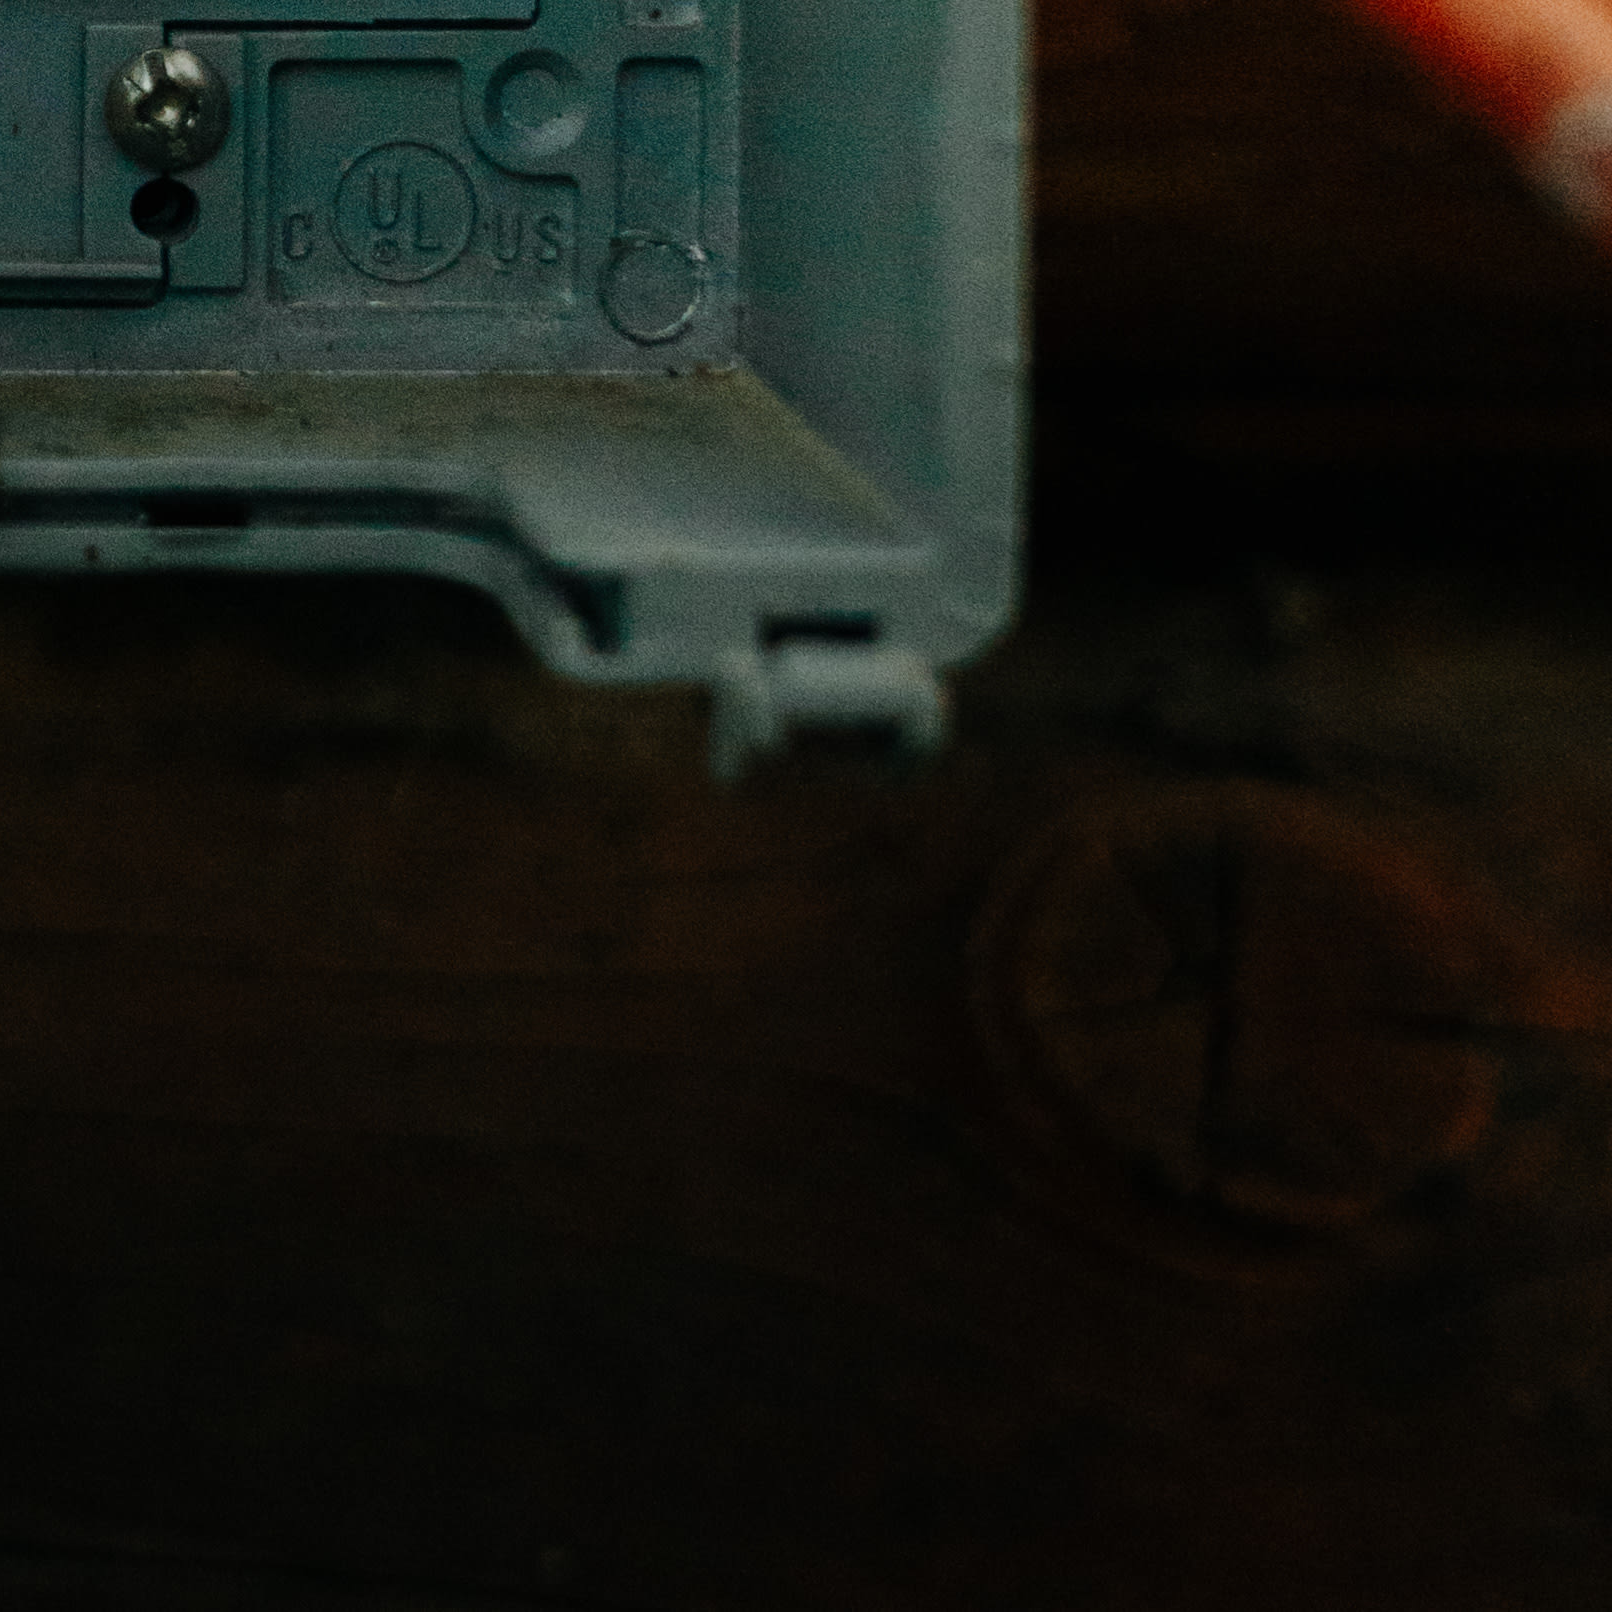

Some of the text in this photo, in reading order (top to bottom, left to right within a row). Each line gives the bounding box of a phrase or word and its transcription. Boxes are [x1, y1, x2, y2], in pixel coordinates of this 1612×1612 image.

[282, 167, 562, 264] C UL US
